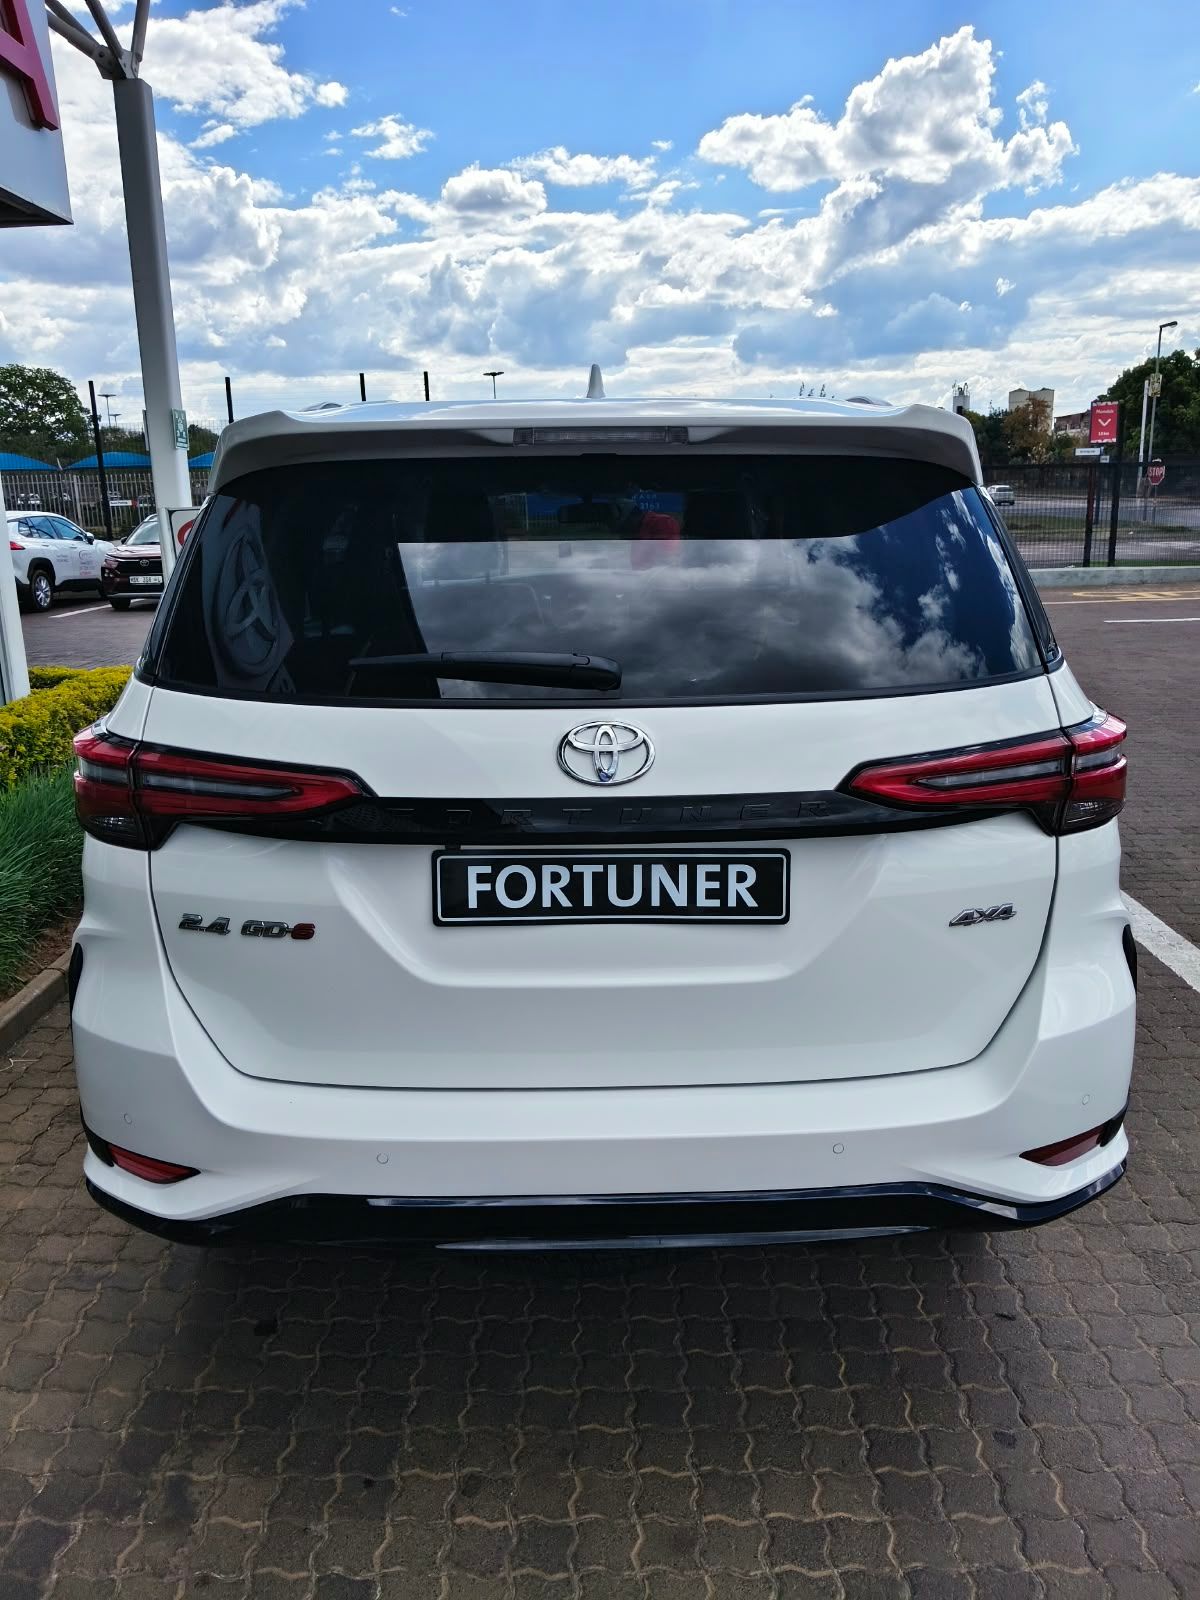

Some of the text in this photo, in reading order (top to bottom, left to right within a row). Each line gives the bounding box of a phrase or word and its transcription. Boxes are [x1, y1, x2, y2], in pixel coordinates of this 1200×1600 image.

[1149, 467, 1163, 477] STOP
[466, 863, 759, 909] FORTUNER
[179, 913, 315, 940] 2.4 GD-6
